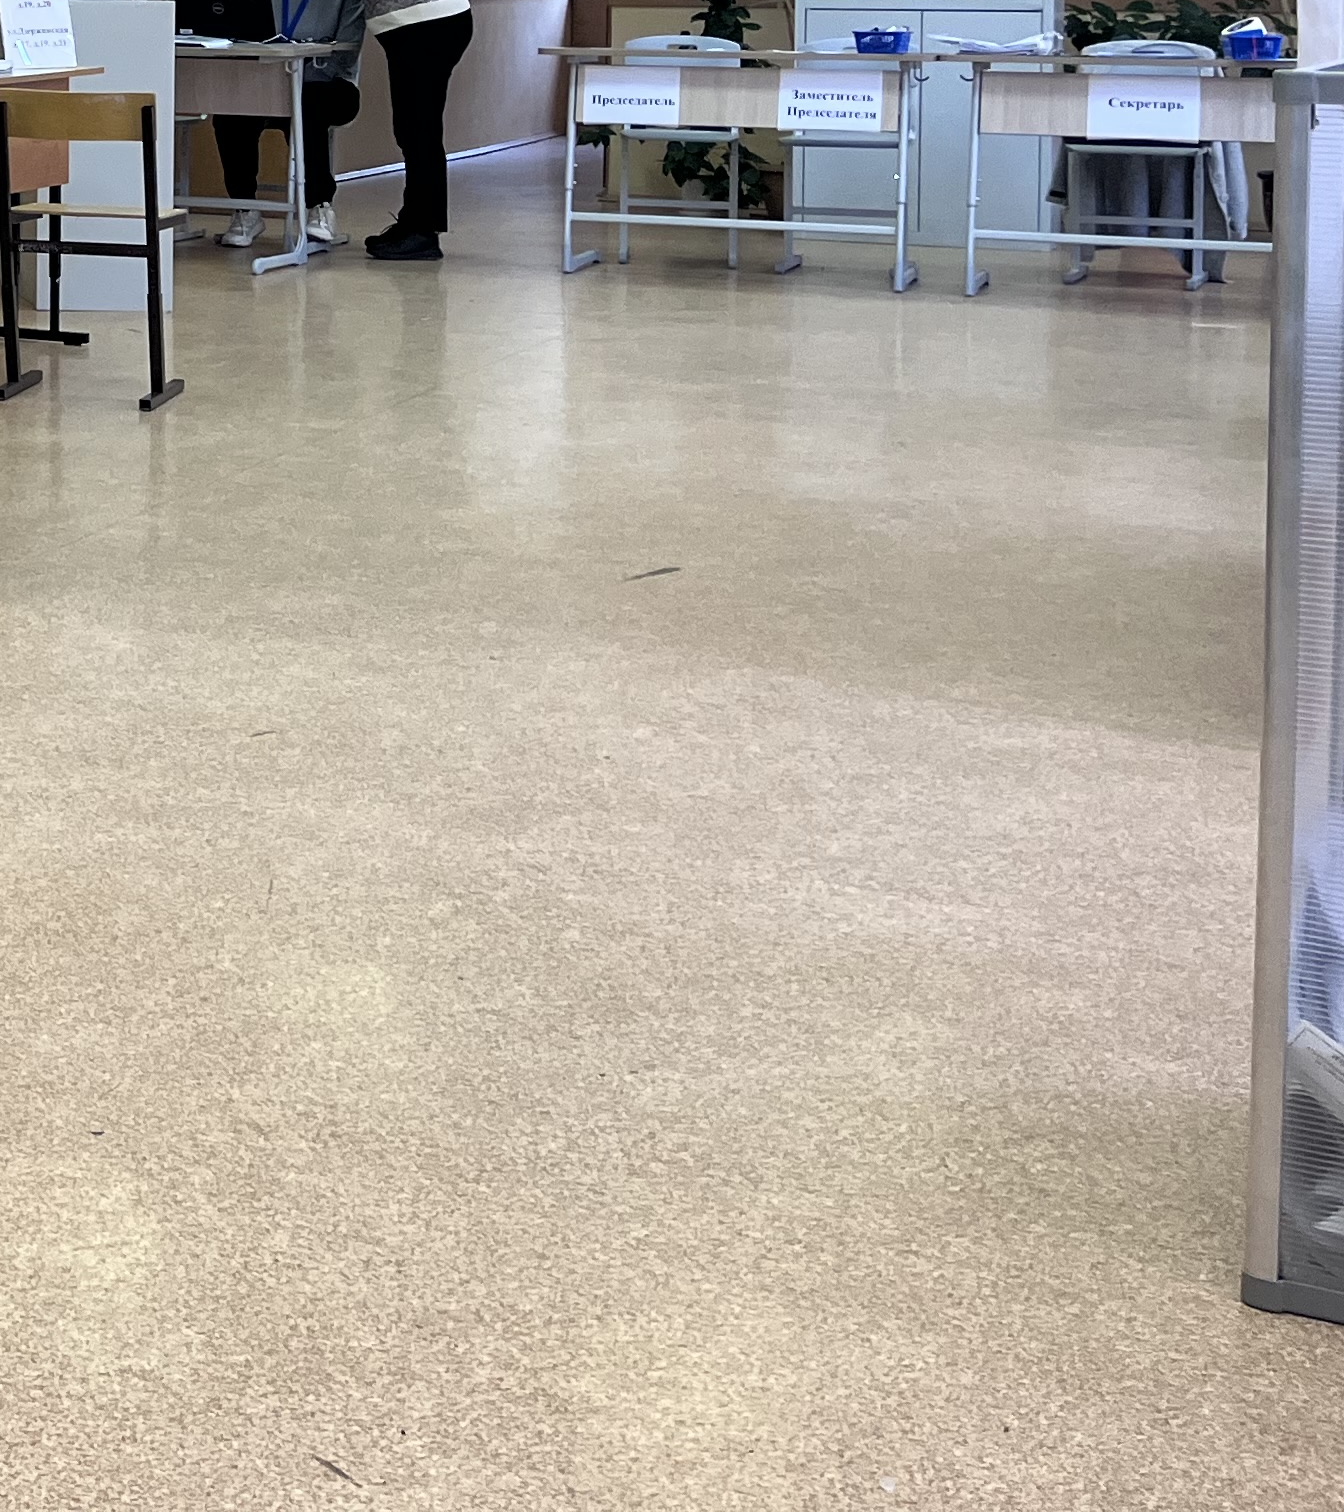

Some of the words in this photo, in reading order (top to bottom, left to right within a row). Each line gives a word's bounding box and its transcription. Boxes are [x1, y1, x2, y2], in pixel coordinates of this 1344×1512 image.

[592, 95, 675, 106] Председатель
[793, 89, 874, 101] Заместитель
[1108, 97, 1184, 112] Секретарь
[788, 107, 876, 119] Председателя
